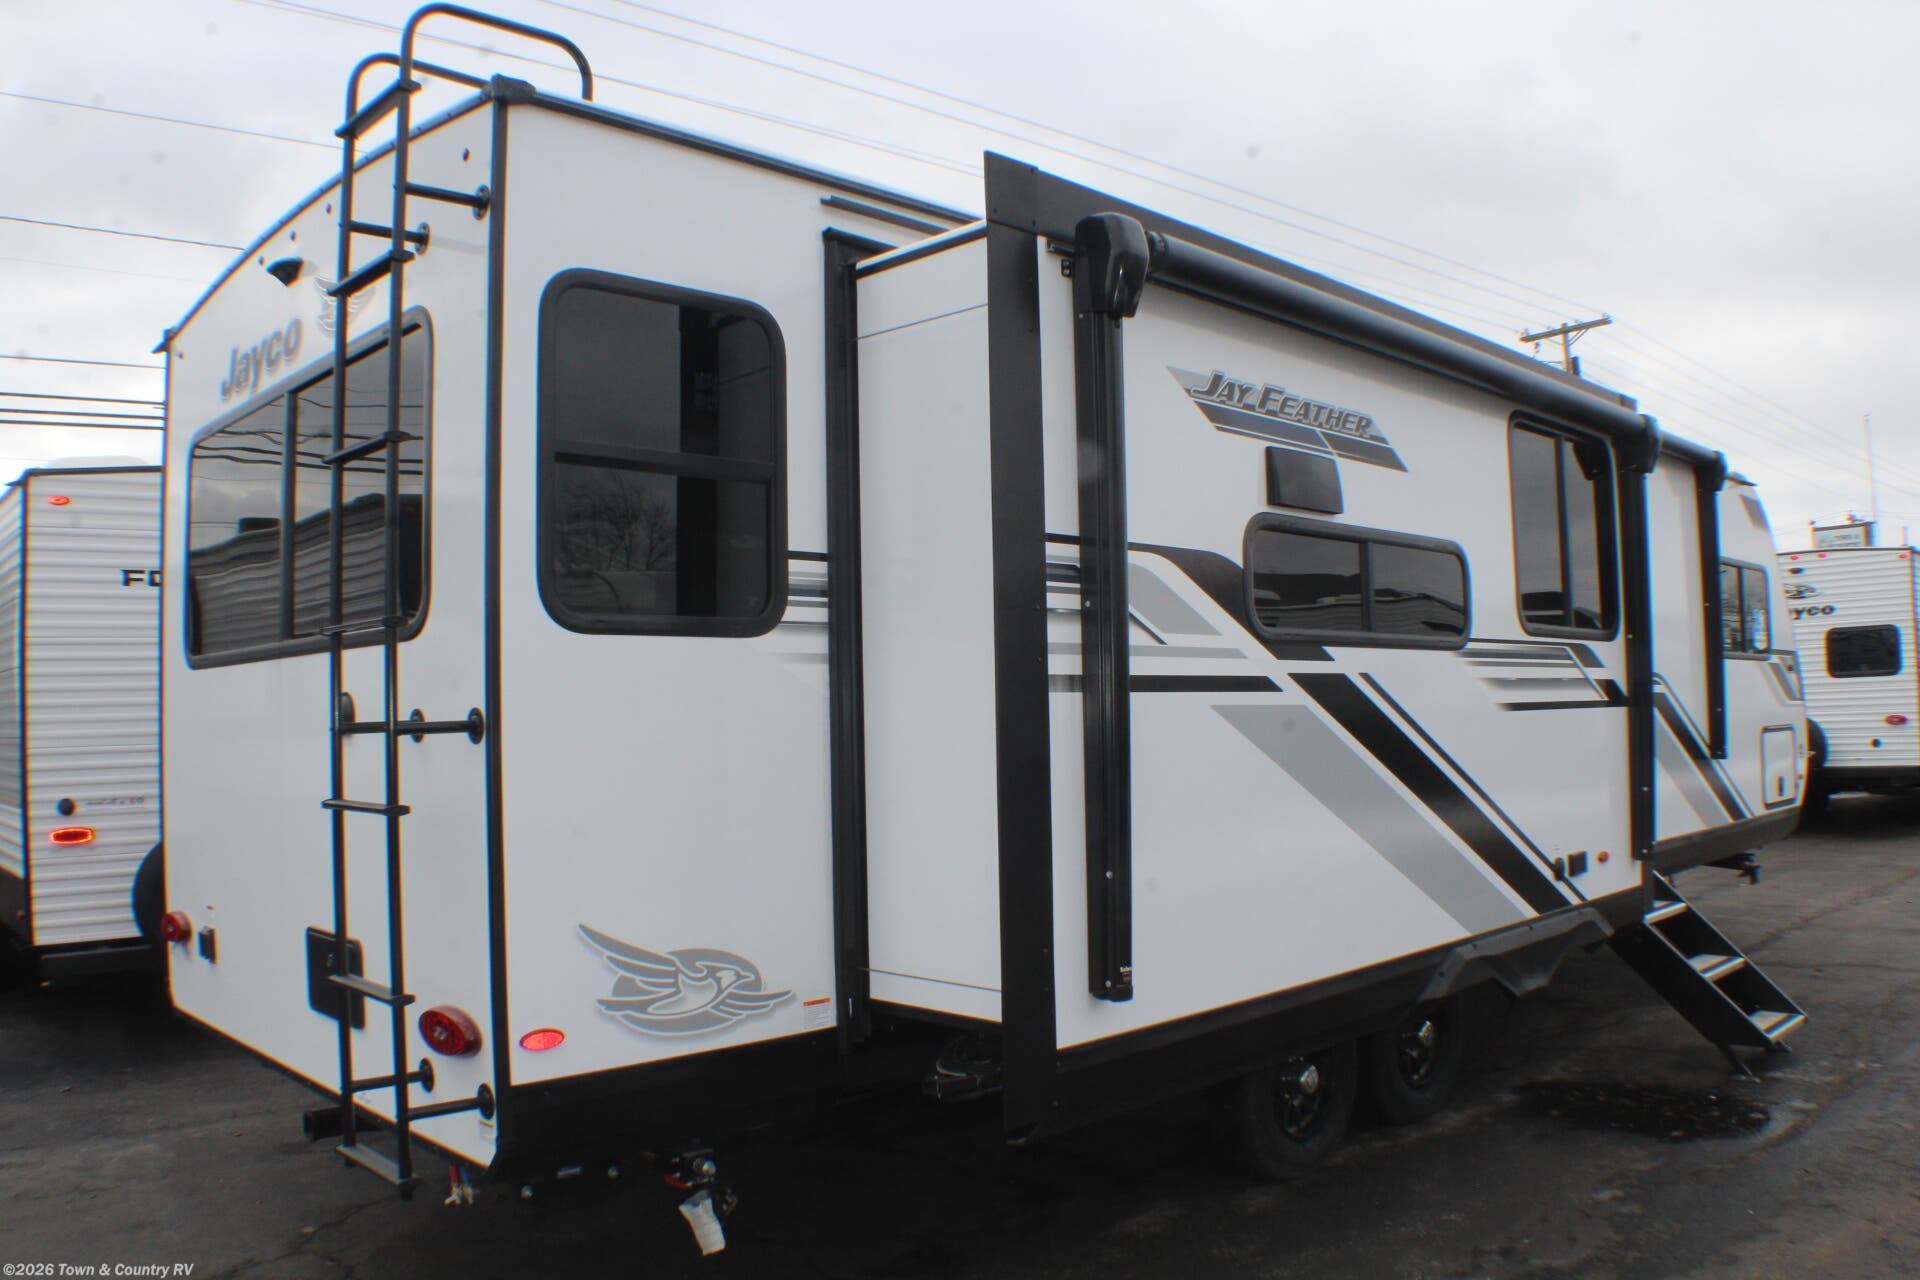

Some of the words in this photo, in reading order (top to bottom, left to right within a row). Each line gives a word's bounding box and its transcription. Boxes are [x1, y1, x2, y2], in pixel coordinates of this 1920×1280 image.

[220, 318, 303, 401] Jayco
[1256, 383, 1374, 437] FEATHER
[1788, 605, 1837, 620] yco
